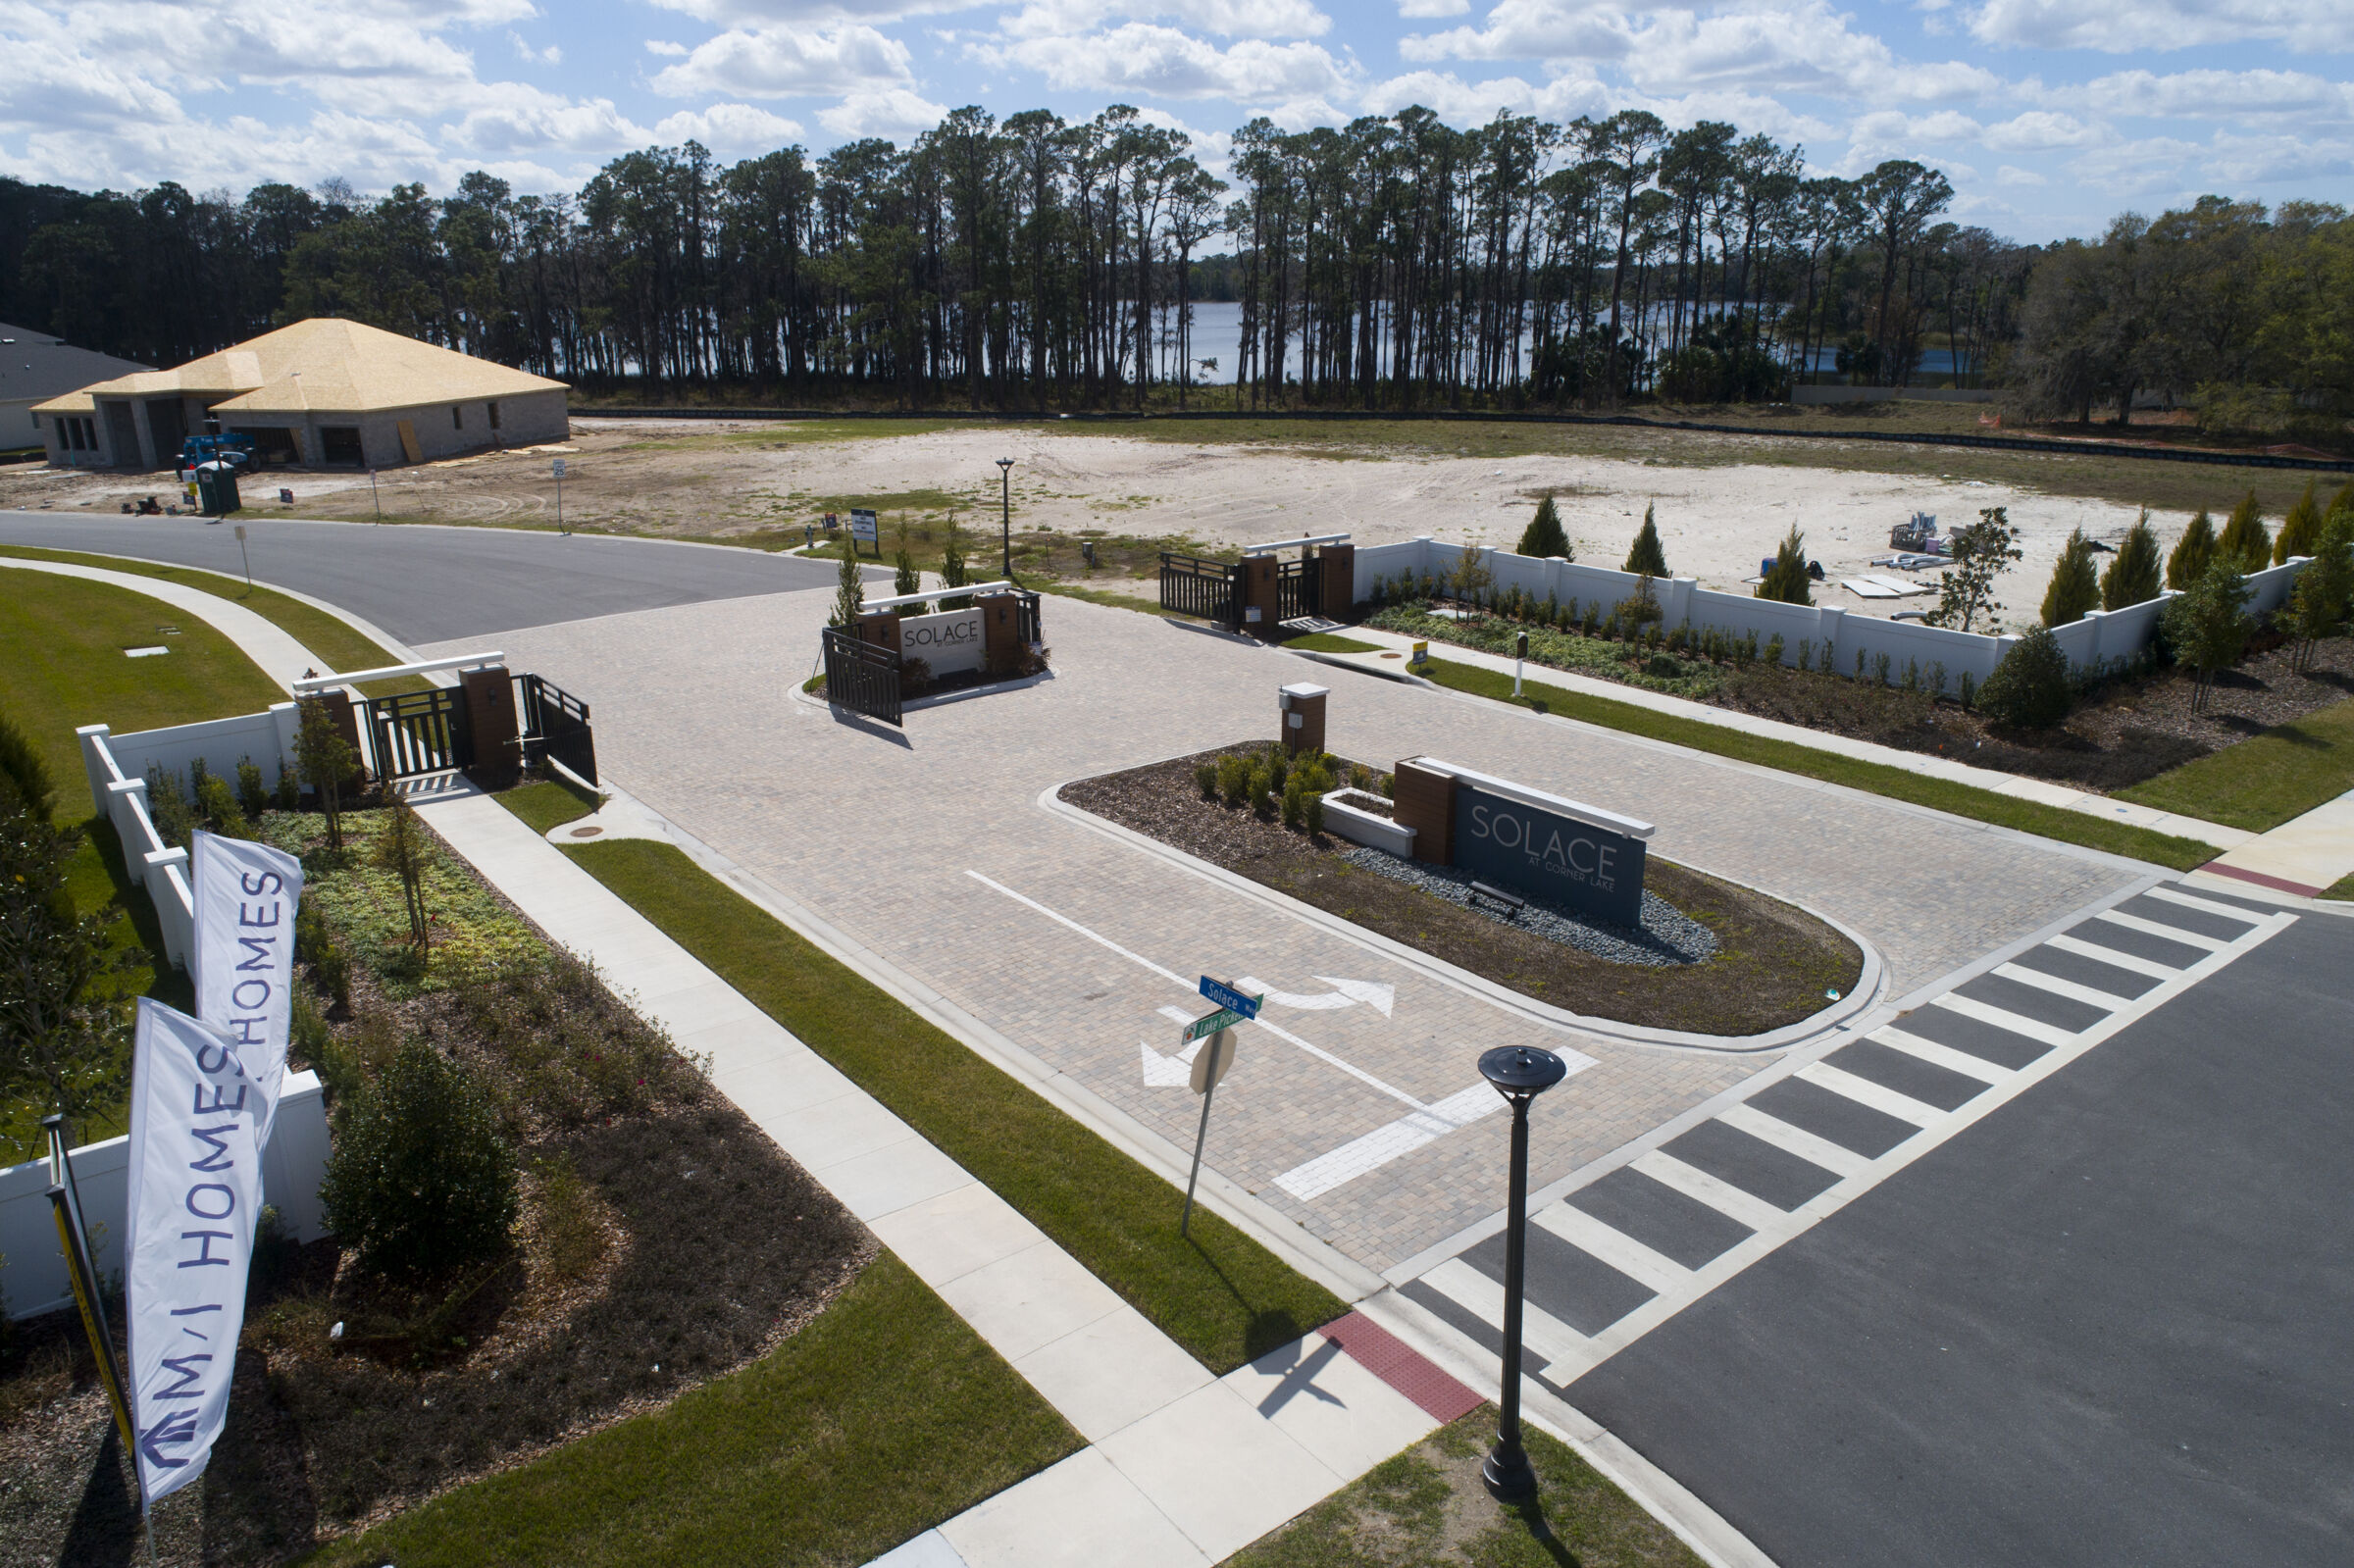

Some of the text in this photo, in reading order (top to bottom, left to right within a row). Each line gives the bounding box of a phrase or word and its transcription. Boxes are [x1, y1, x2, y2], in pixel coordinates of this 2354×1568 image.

[904, 621, 978, 647] SOLACE
[1471, 805, 1617, 882] SOLACE
[1528, 855, 1615, 893] AT CORNER LAKE
[230, 871, 283, 1046] HOMES
[1207, 983, 1238, 1009] Solace
[1199, 1020, 1216, 1036] Lake
[178, 1043, 247, 1269] HOMES
